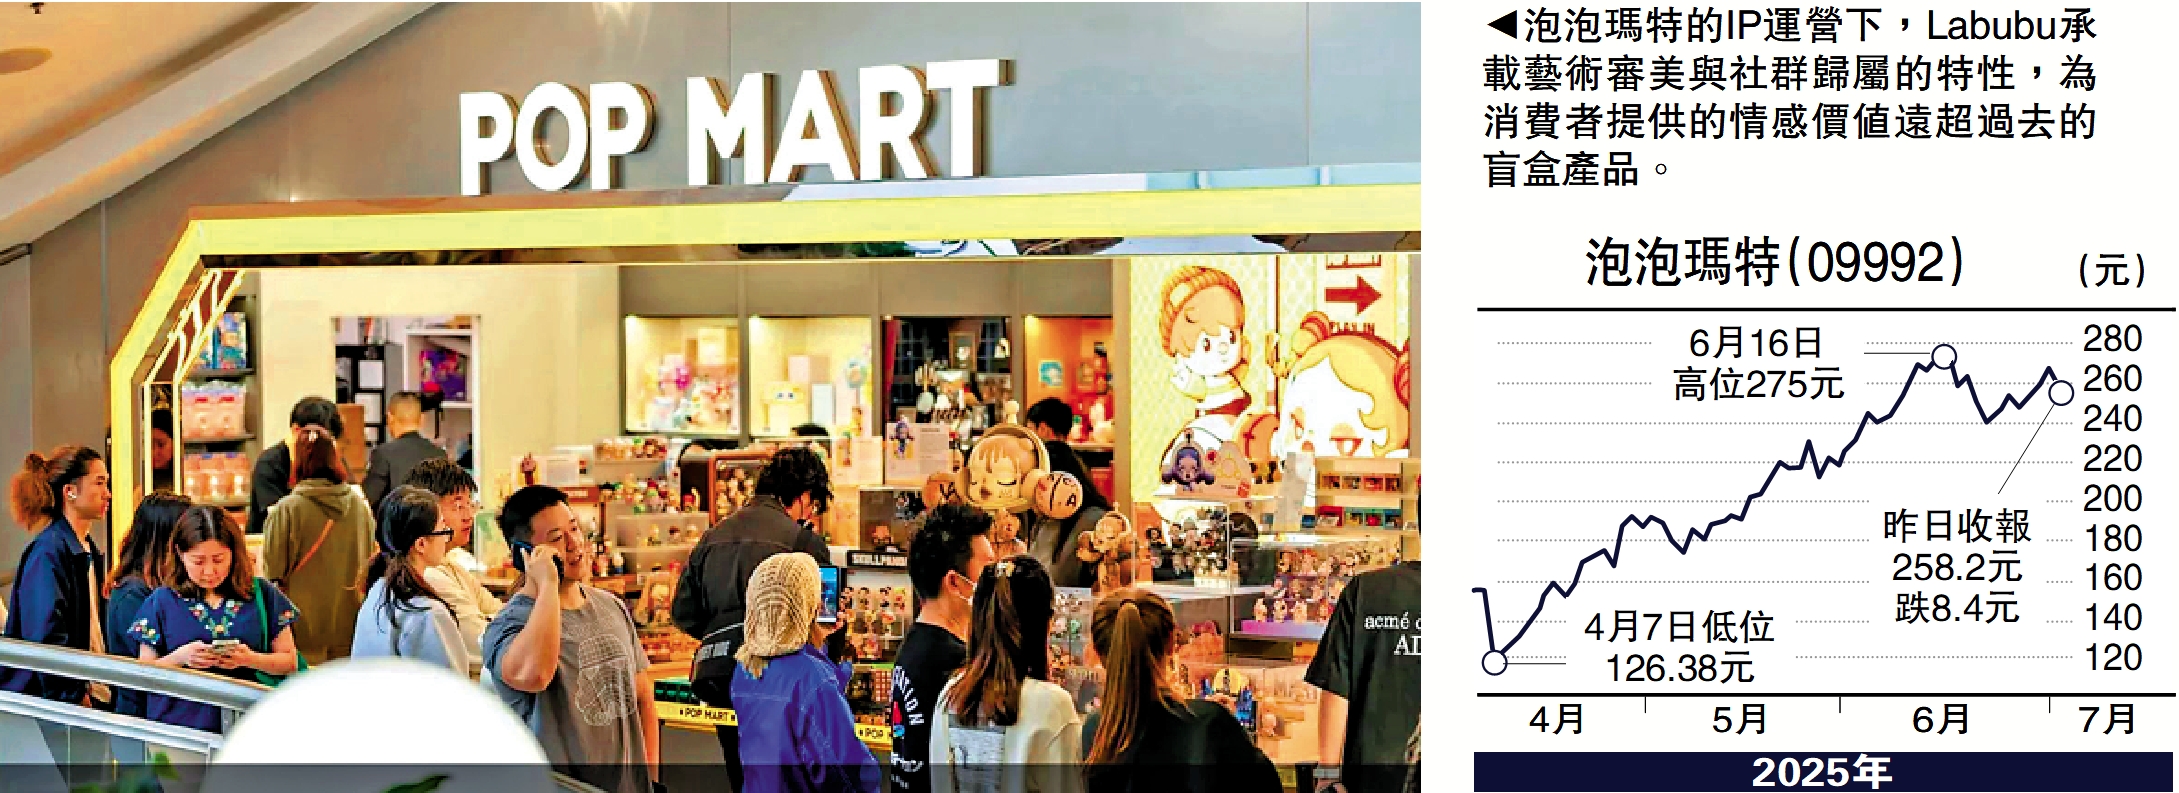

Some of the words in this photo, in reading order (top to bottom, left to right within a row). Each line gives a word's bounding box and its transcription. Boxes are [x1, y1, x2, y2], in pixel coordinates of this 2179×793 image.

[460, 81, 655, 196] POP
[687, 58, 1006, 187] MART
[1364, 610, 1410, 630] acmé
